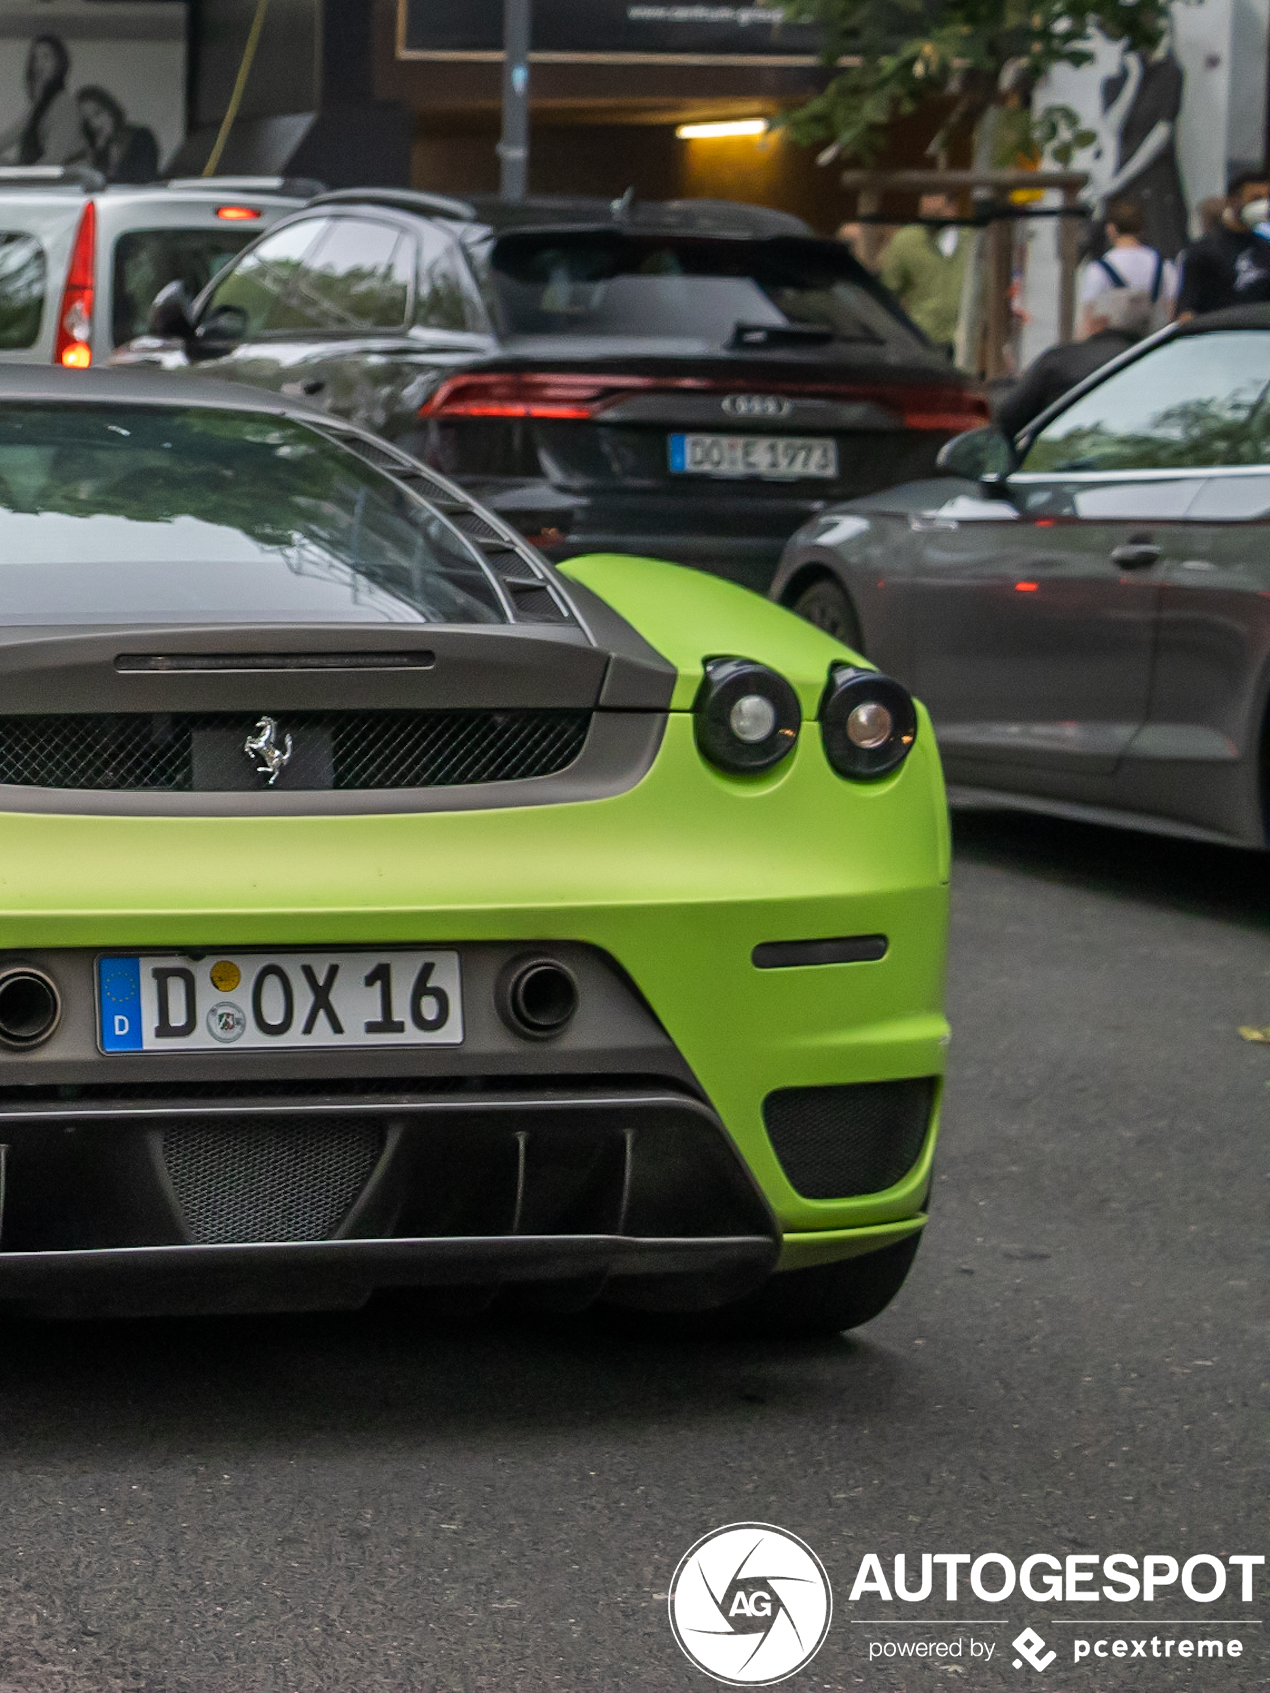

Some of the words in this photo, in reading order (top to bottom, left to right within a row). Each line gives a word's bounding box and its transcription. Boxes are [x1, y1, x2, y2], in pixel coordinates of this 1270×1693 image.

[114, 1014, 129, 1036] D
[151, 966, 197, 1039] D
[251, 962, 345, 1037] OX
[363, 961, 450, 1035] 16
